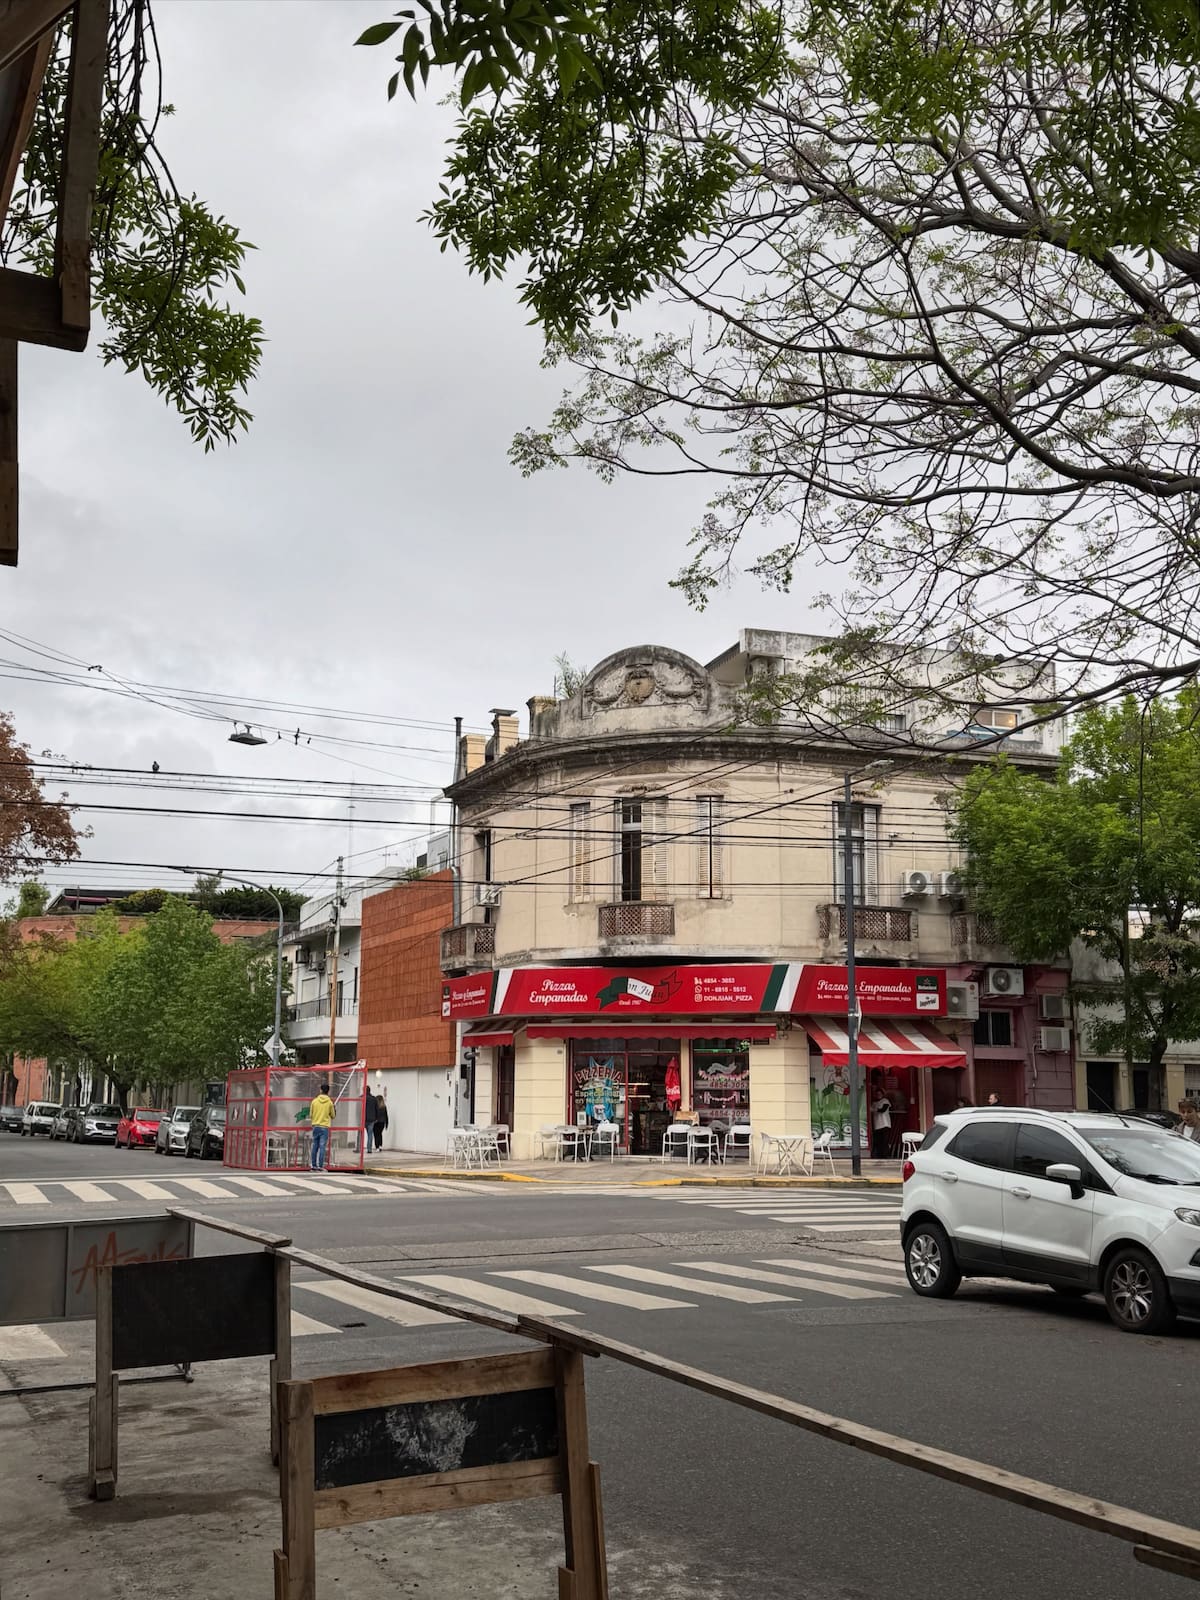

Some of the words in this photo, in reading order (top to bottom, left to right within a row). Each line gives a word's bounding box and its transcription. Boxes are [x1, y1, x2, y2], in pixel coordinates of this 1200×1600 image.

[542, 979, 576, 992] Pizzas
[817, 979, 848, 991] Pizzas
[859, 981, 912, 995] Empanadas
[529, 989, 588, 1006] Empanadas
[575, 1065, 623, 1083] PIZZERIA
